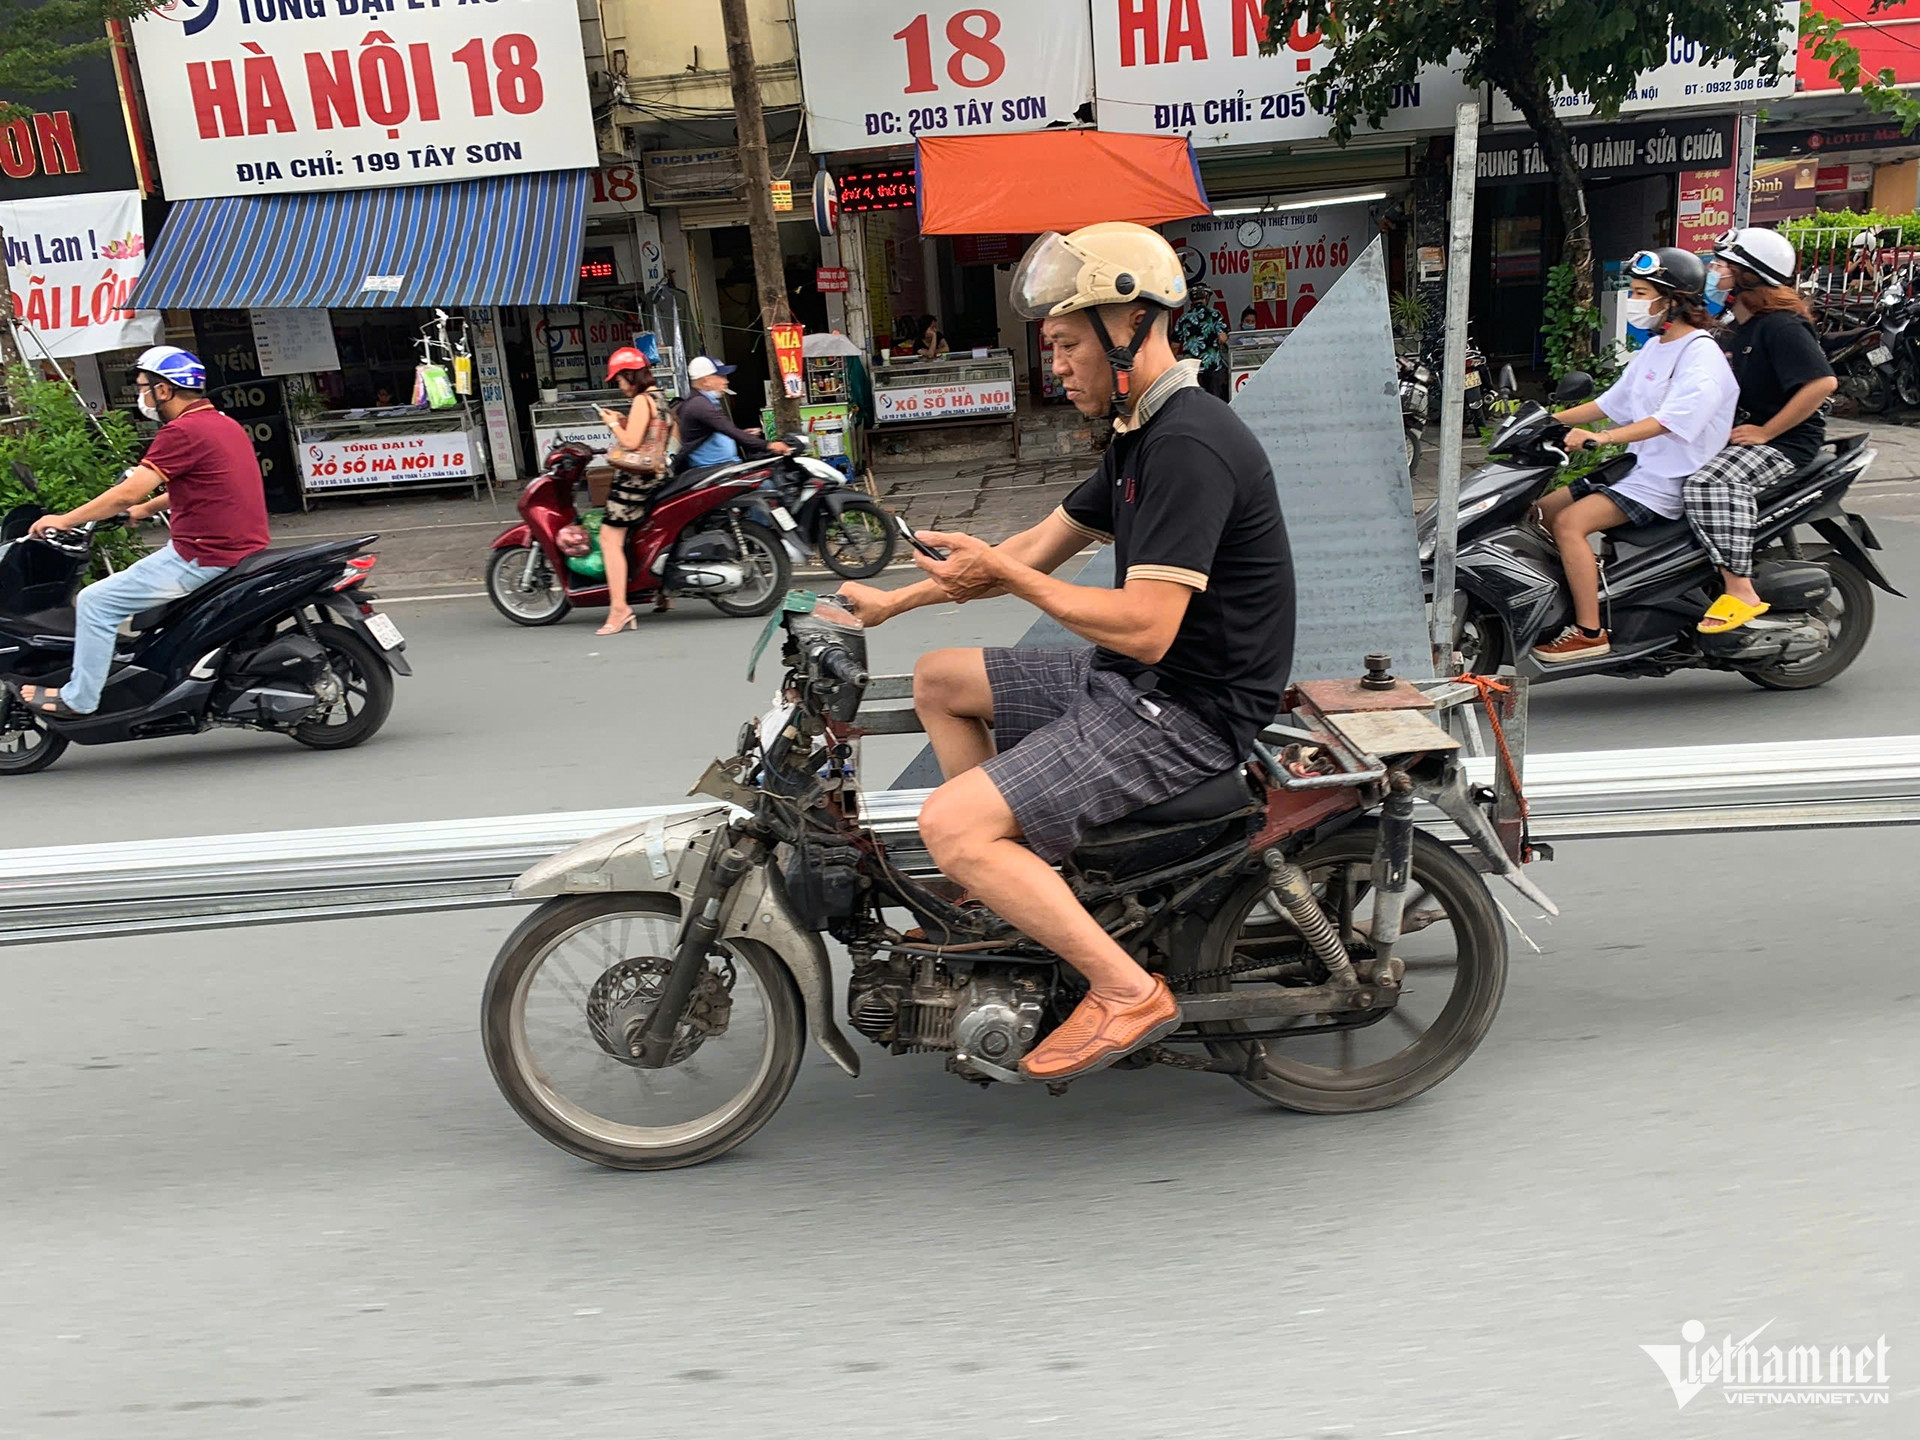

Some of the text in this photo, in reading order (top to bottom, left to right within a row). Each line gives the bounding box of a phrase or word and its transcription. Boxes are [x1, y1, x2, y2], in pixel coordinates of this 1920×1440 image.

[893, 9, 1006, 94] 18
[186, 30, 545, 140] HÀ NỘI 18
[1685, 84, 1697, 96] ĐT
[1706, 81, 1732, 95] 0932
[1734, 79, 1755, 92] 308
[865, 96, 1047, 136] ĐC: 203 TÂY SƠN
[1154, 103, 1196, 133] ĐỊA
[1204, 89, 1252, 123] CHỈ:
[1260, 92, 1306, 120] 205
[236, 140, 523, 184] ĐỊA CHỈ: 199 TÂY SƠN
[1592, 136, 1636, 168] HÀNH
[1646, 128, 1677, 165] SỬA
[1683, 127, 1723, 162] CHỮA
[591, 165, 638, 203] 18
[1191, 220, 1212, 233] CÔNG
[1214, 223, 1222, 231] TY
[34, 234, 83, 264] Lan
[88, 229, 98, 259] !
[1210, 241, 1250, 275] TỔNG
[1285, 241, 1301, 270] LÝ
[1305, 234, 1326, 268] XỔ
[1330, 235, 1350, 267] SỐ
[774, 327, 801, 349] MÍA
[780, 351, 799, 373] ĐÁ
[895, 389, 1010, 412] XỔ SỐ HÀ NỘI
[382, 440, 405, 452] ĐẠI
[409, 440, 424, 448] LÝ
[564, 432, 586, 441] TỔNG
[587, 433, 601, 441] ĐẠI
[311, 452, 465, 477] XỔ SỐ HÀ NỘI 18
